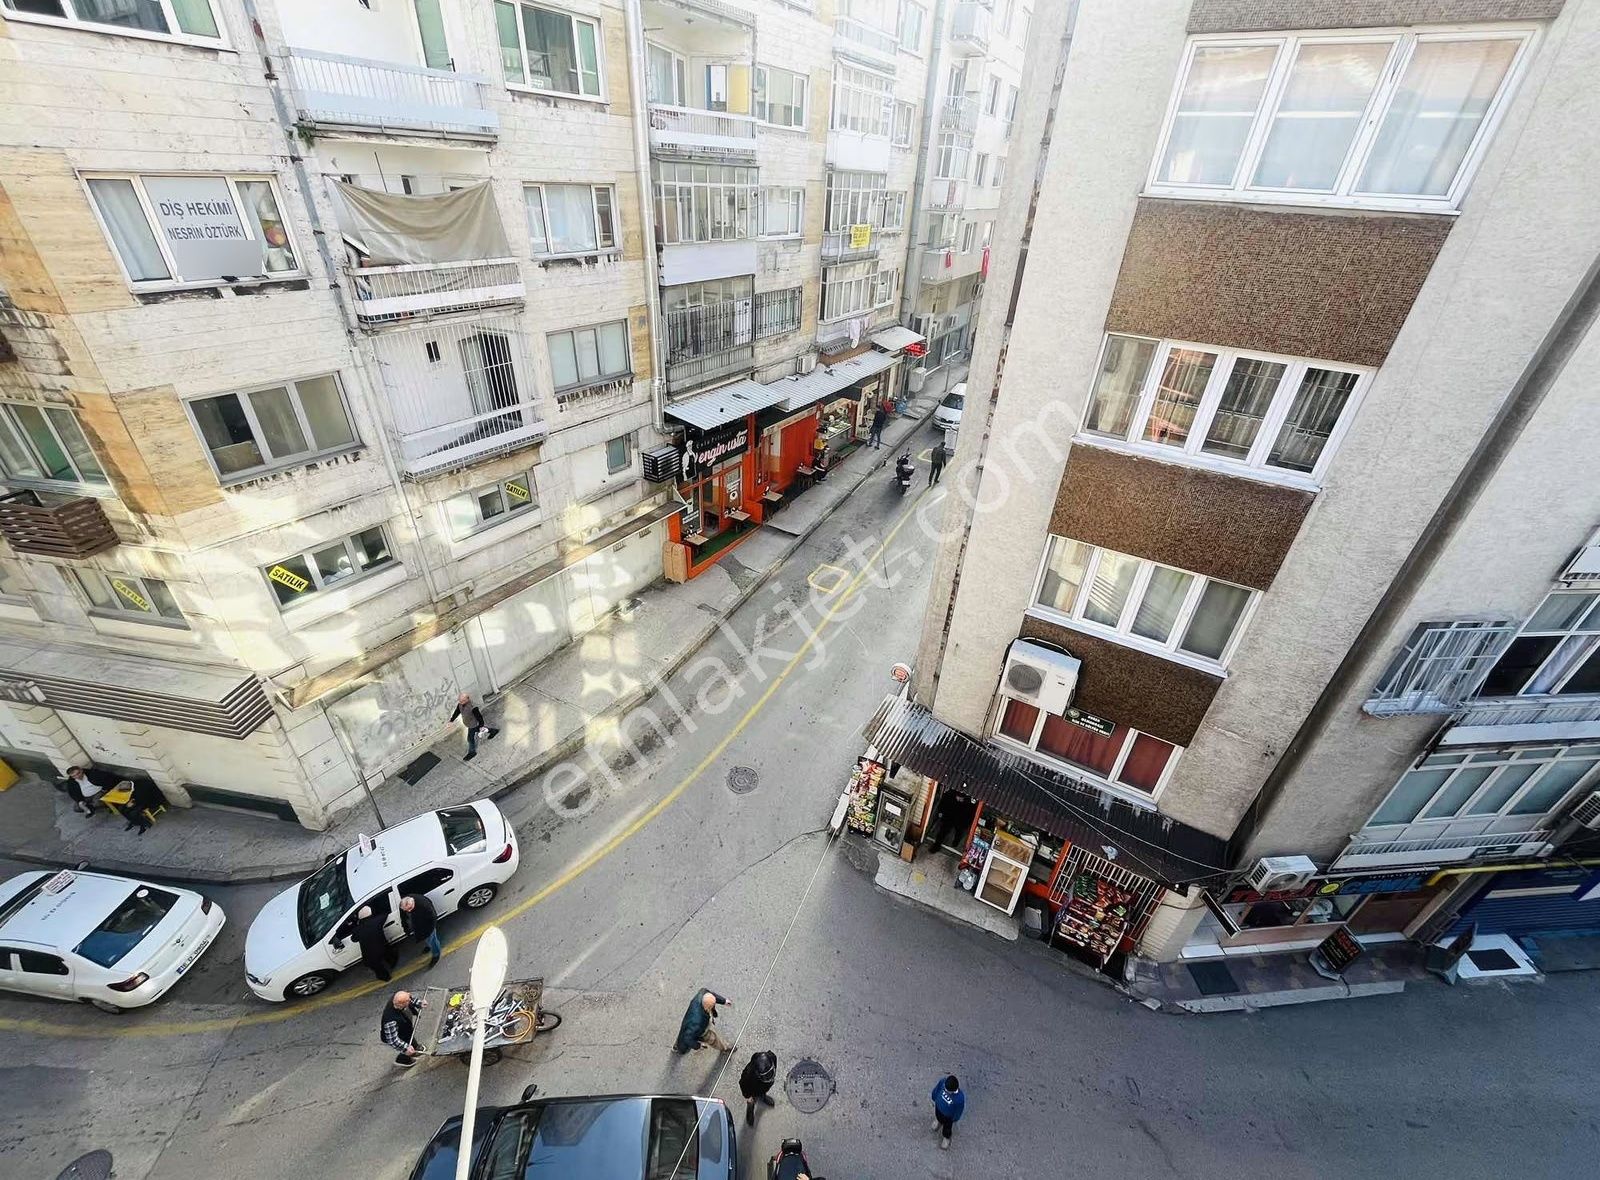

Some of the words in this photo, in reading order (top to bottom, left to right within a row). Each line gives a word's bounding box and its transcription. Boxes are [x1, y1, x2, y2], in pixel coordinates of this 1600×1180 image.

[160, 199, 184, 219] DİŞ
[187, 199, 232, 216] HEKİMİ
[205, 223, 241, 239] ÖZTÜRK
[505, 484, 527, 498] SATILIK
[272, 568, 305, 590] SATILIK
